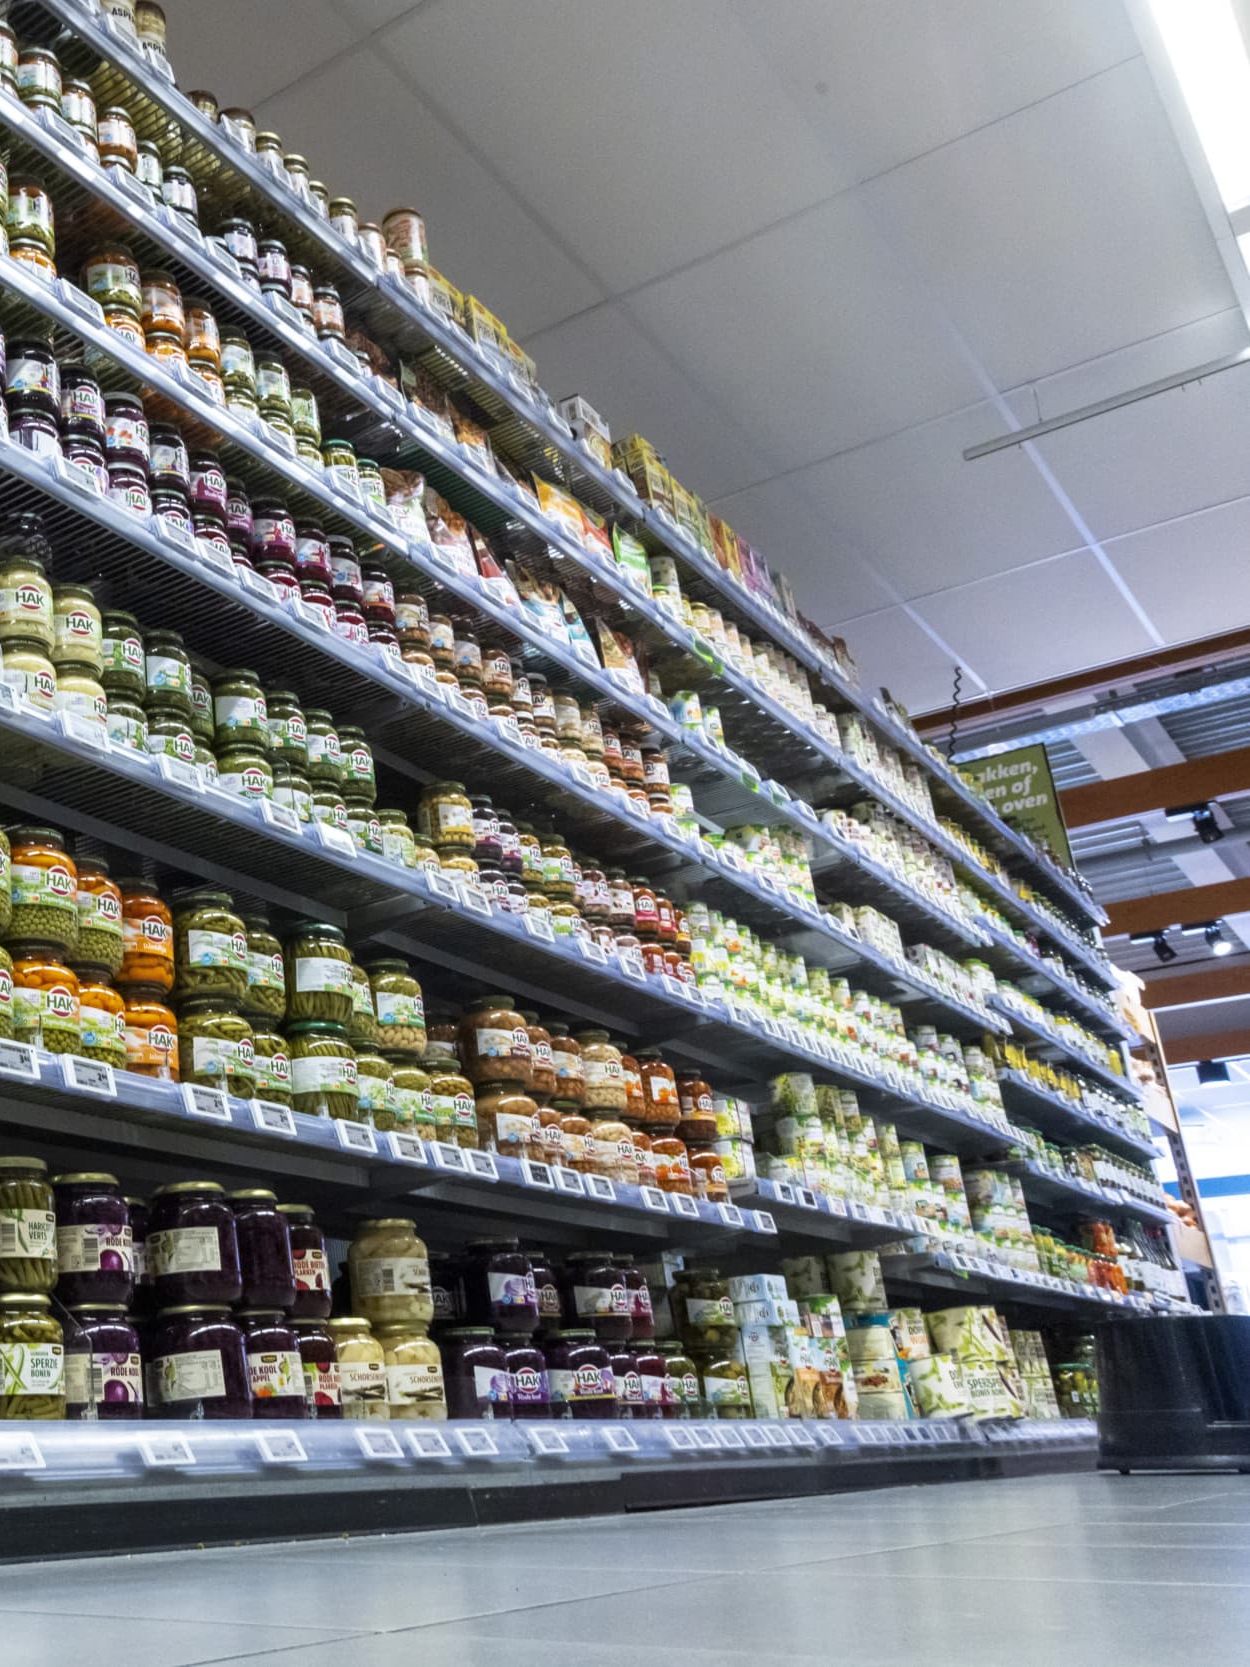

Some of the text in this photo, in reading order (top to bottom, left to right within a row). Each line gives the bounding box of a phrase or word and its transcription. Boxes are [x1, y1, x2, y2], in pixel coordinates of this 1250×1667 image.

[15, 591, 44, 607] HAK
[65, 616, 93, 632] HAK
[34, 675, 56, 691] HAK
[350, 755, 371, 768] HAK
[241, 774, 268, 787] HAK
[1011, 774, 1032, 797] of
[1002, 793, 1048, 814] oven
[46, 874, 73, 892] HAK
[97, 898, 120, 915] HAK
[141, 922, 168, 938] HAK
[46, 995, 73, 1012] HAK
[149, 1033, 176, 1048] HAK
[28, 1231, 47, 1240] VERTS
[30, 1358, 58, 1369] SPERZIE
[110, 1365, 128, 1376] RODE
[259, 1364, 277, 1375] KOOL
[30, 1368, 51, 1378] BONEN
[576, 1372, 600, 1383] HAK
[515, 1375, 539, 1387] HAK
